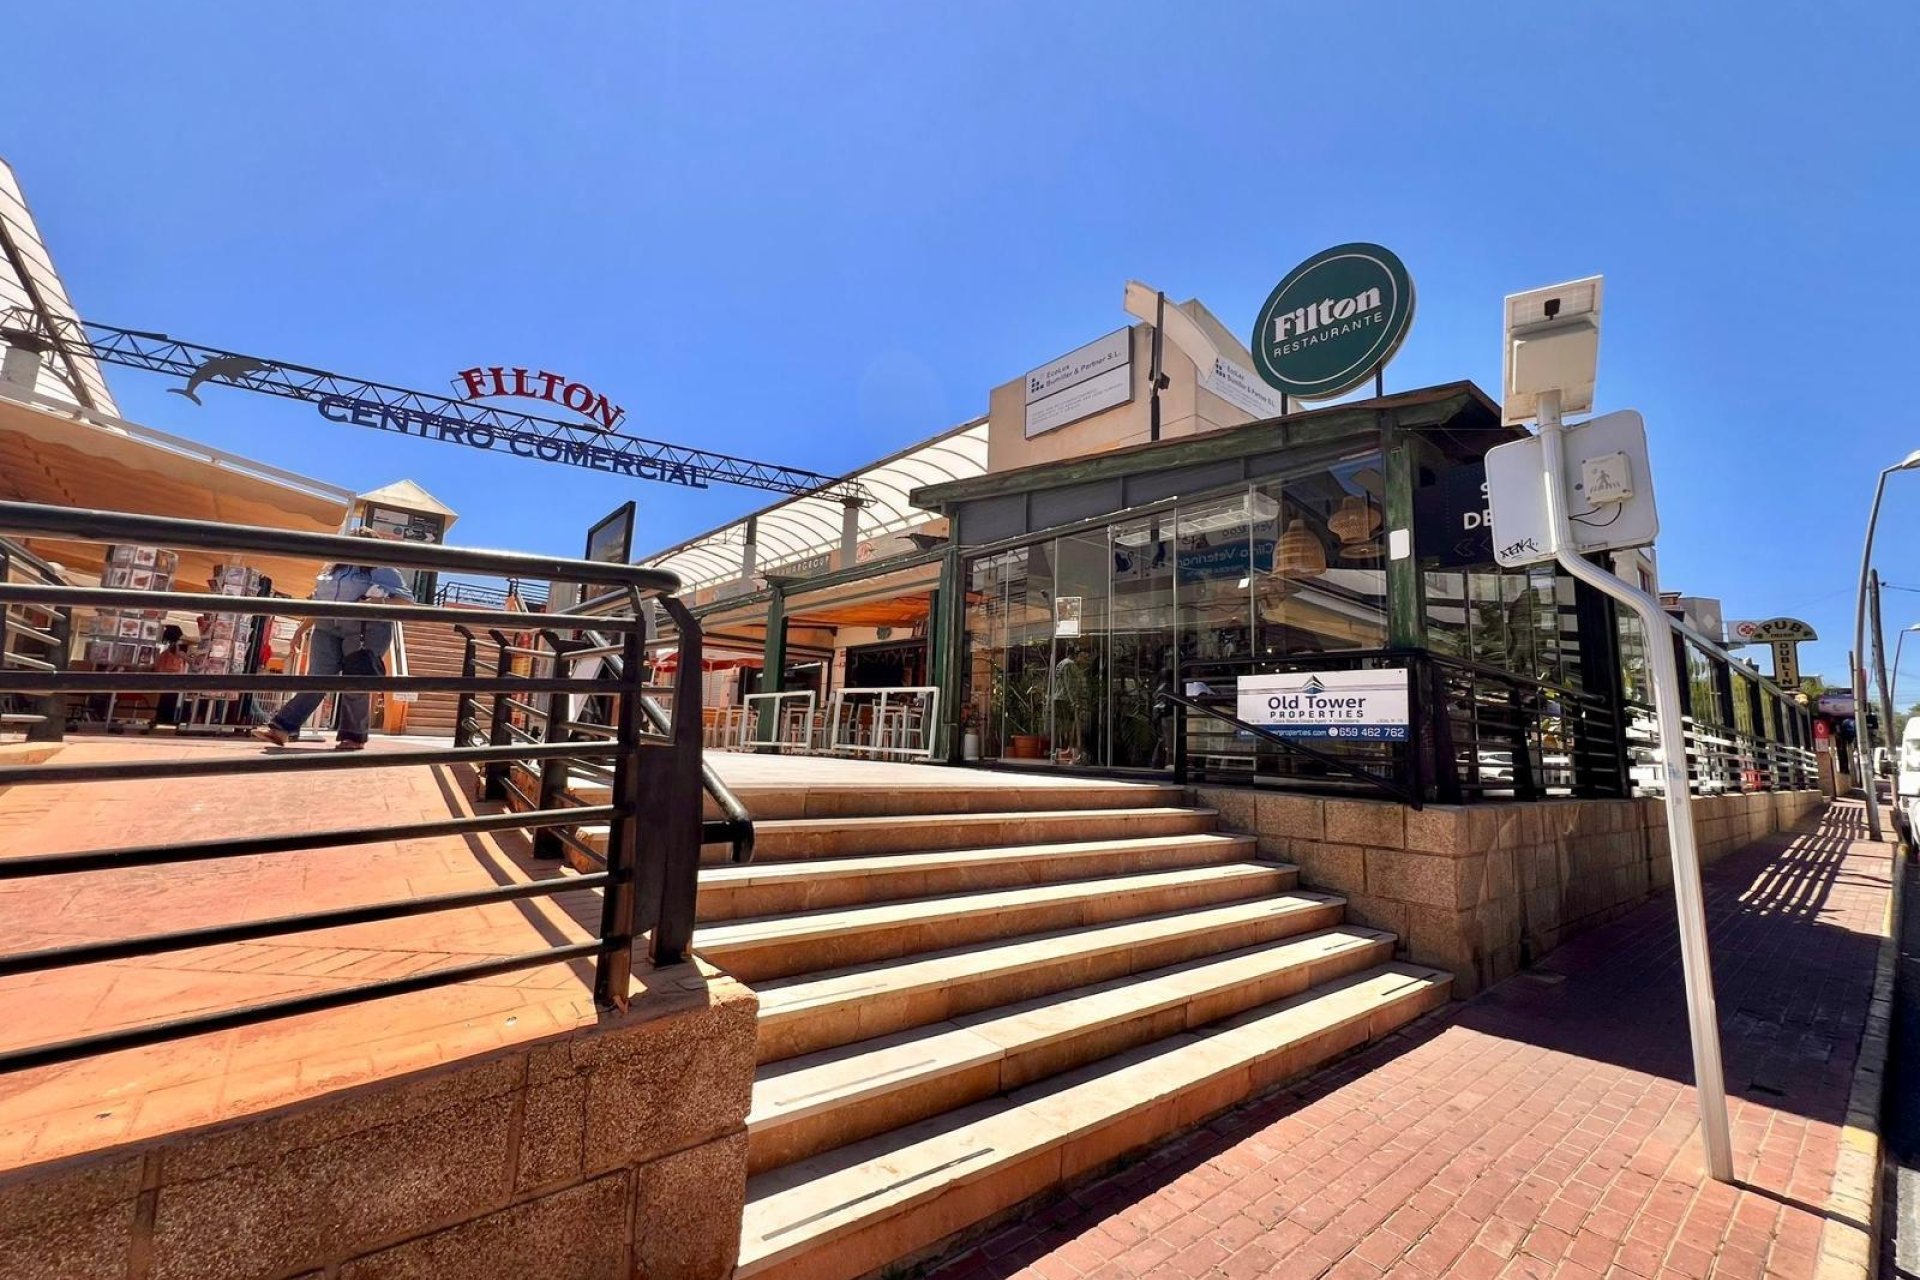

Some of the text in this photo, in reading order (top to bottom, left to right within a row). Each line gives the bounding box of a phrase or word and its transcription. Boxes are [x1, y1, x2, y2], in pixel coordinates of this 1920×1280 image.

[1273, 287, 1382, 344] Filton
[1273, 311, 1383, 358] RESTAURANTE
[458, 366, 625, 431] FILTON
[318, 394, 709, 490] CENTRO COMERCIAL
[1762, 621, 1802, 634] PUB
[1779, 642, 1793, 685] DUBLIN
[1268, 695, 1366, 709] Old Tower
[1270, 710, 1364, 718] PROPERTIES
[1338, 727, 1358, 737] 659
[1361, 727, 1381, 737] 462
[1384, 727, 1405, 737] 762
